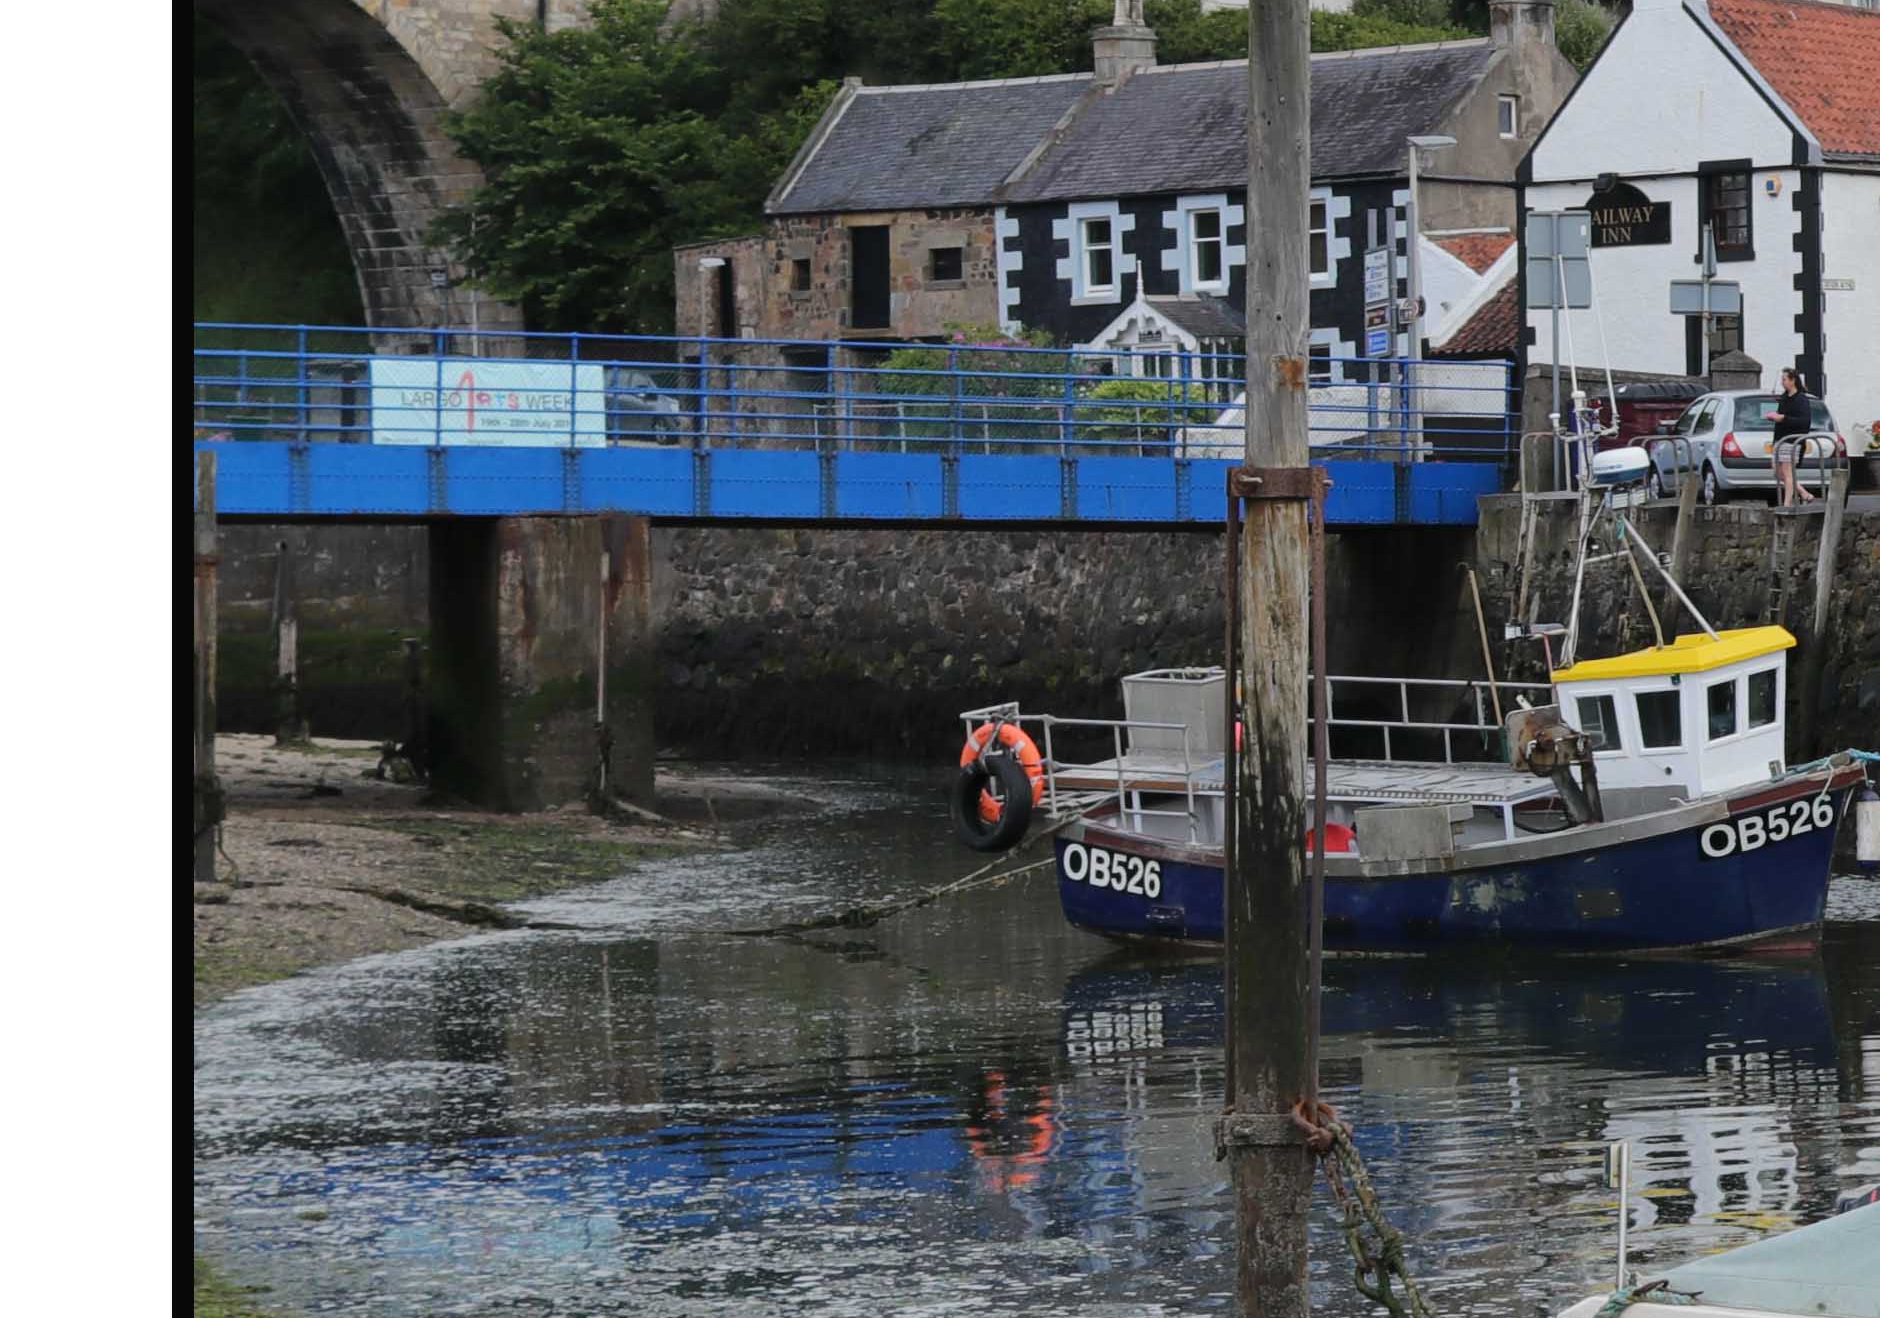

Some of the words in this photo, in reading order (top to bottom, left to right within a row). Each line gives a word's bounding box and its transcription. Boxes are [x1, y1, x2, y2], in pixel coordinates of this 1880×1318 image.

[1592, 205, 1655, 226] AILWAY
[1602, 226, 1632, 244] INN
[525, 393, 575, 411] WEEK
[1700, 794, 1834, 858] OB526
[1063, 843, 1161, 898] OB526
